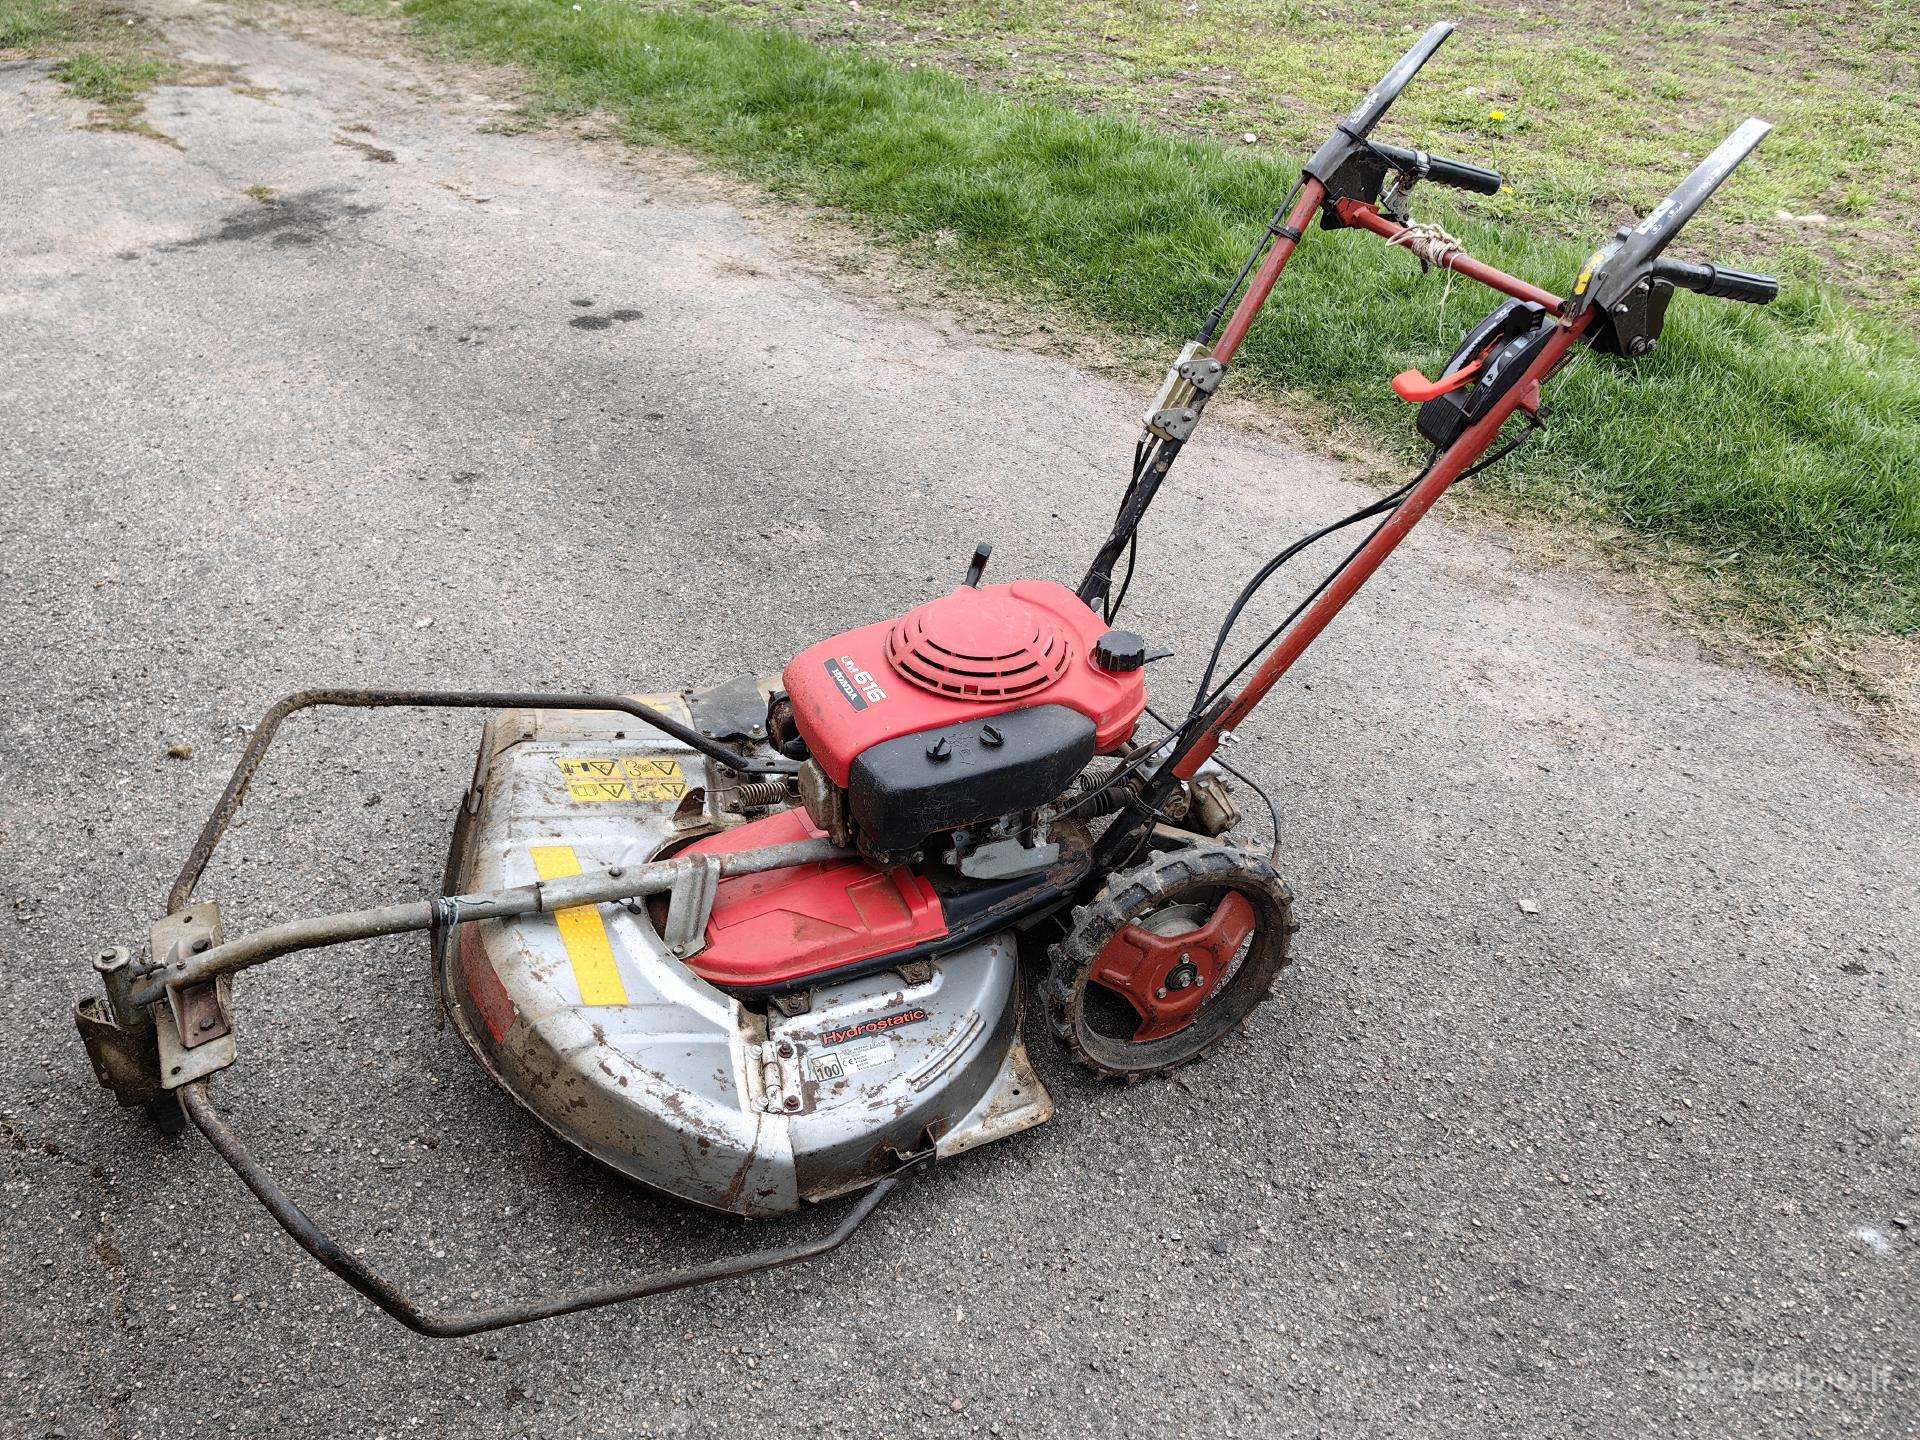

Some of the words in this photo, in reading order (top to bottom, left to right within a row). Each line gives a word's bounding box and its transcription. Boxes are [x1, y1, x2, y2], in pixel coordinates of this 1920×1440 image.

[832, 668, 858, 701] HONDA
[821, 1009, 925, 1046] Hydrostatic
[816, 1063, 841, 1080] 100
